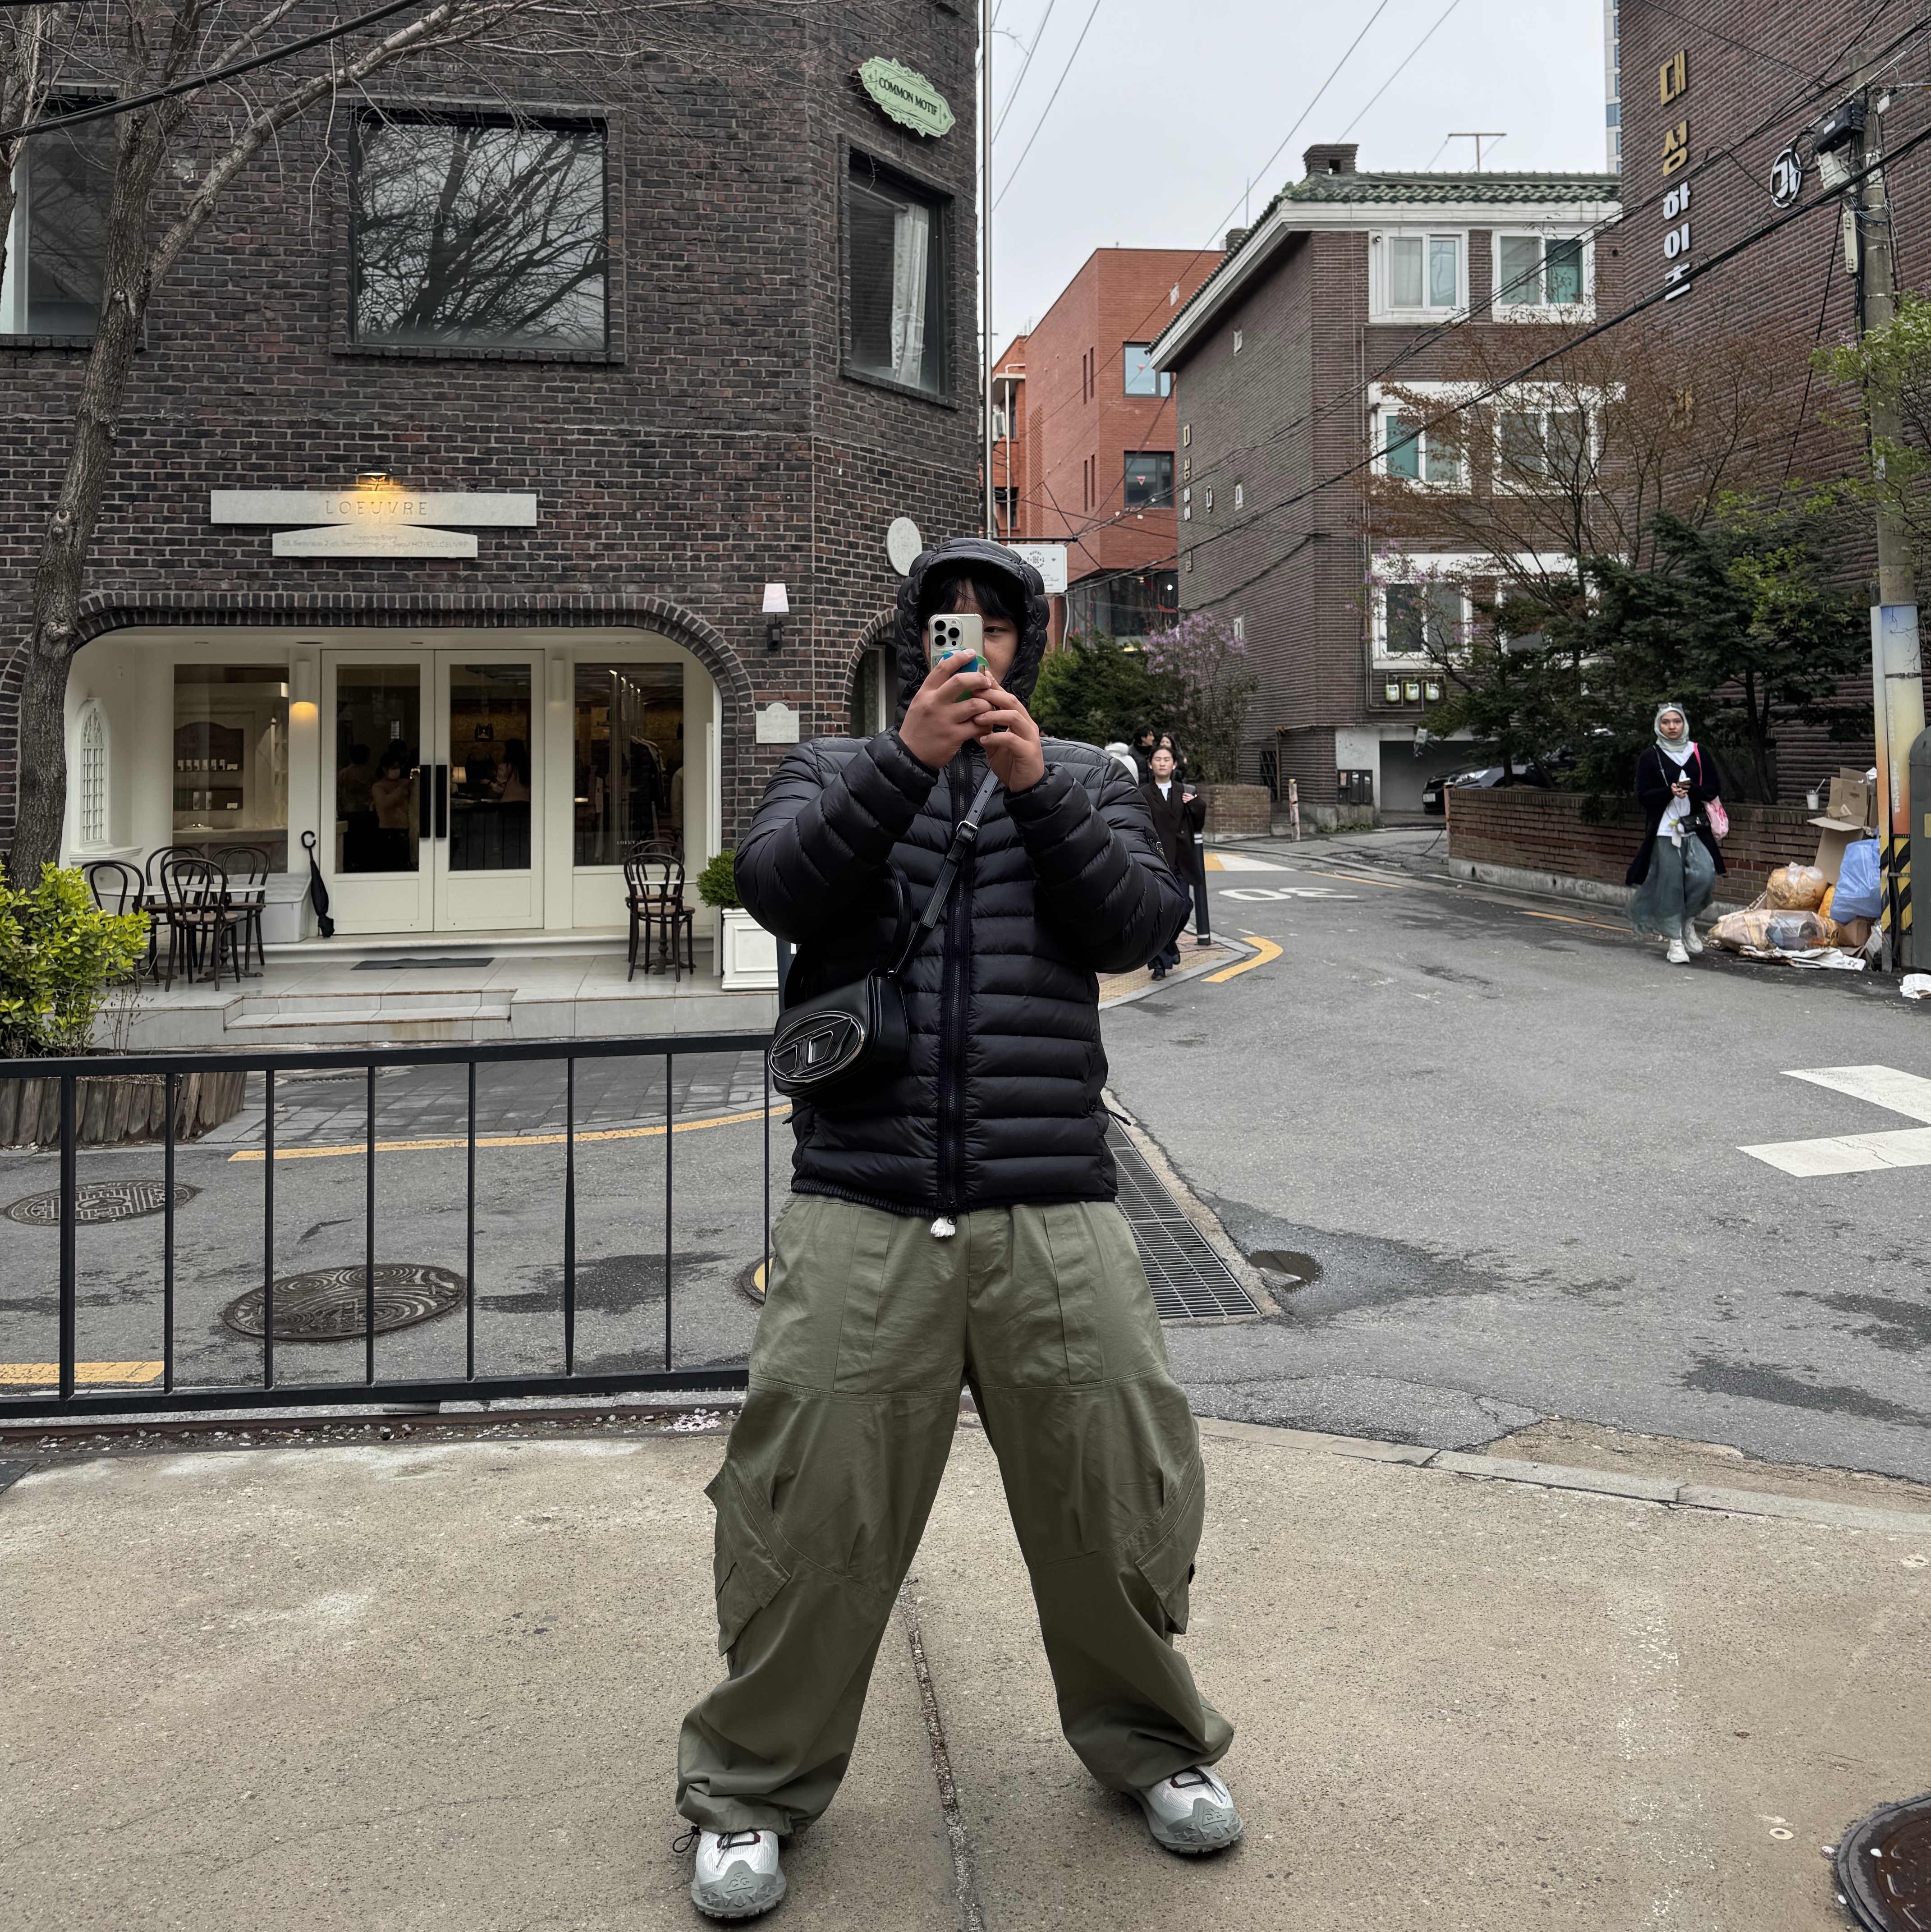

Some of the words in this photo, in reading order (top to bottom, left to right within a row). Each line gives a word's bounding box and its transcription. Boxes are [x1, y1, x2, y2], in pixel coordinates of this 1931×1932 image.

[879, 78, 913, 103] COMMON
[914, 95, 937, 115] MOTIF
[326, 500, 427, 515] LOEUVRE
